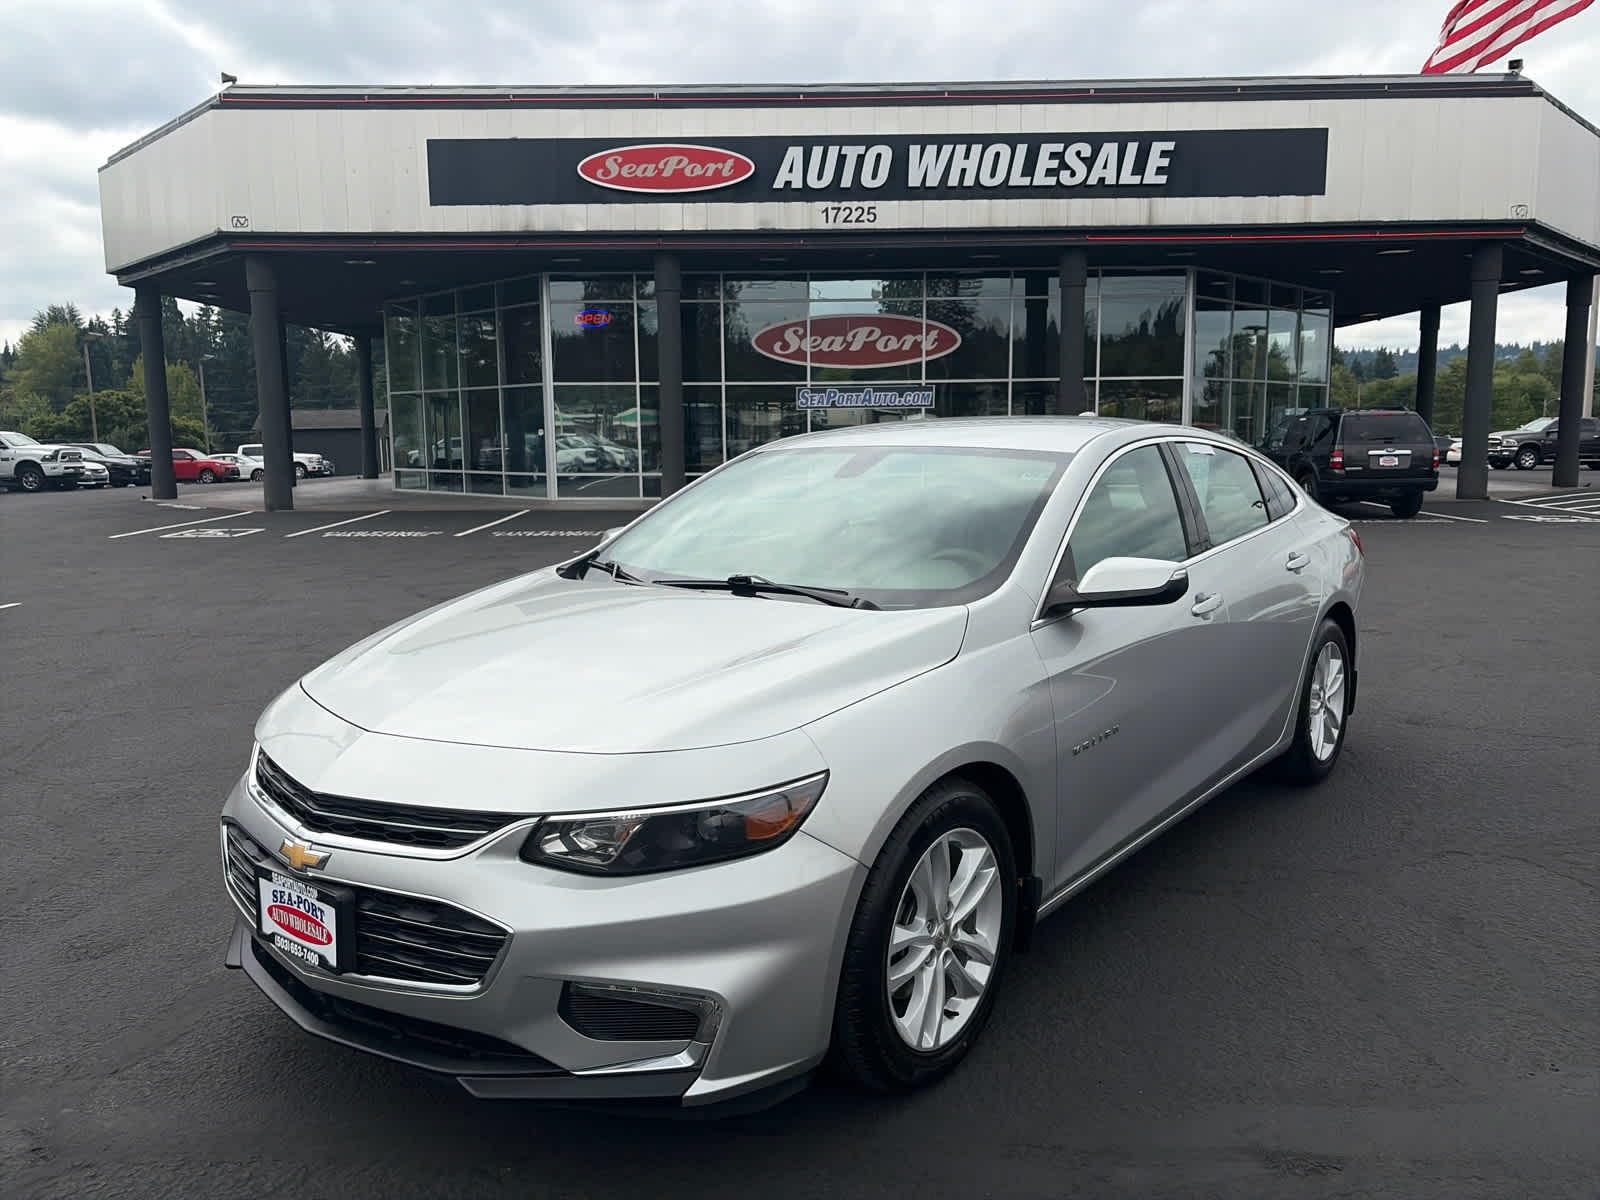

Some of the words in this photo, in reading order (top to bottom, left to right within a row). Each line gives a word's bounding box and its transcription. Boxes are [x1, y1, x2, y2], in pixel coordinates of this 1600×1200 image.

[596, 156, 735, 180] SeaPort
[772, 144, 893, 189] AUTO
[906, 141, 1176, 188] WHOLESALE
[821, 206, 877, 224] 17225
[574, 313, 612, 325] OPEN
[773, 327, 938, 354] SeaPort
[272, 906, 289, 925] AUTO
[289, 914, 328, 944] WHOLESALE
[274, 935, 290, 951] (503)
